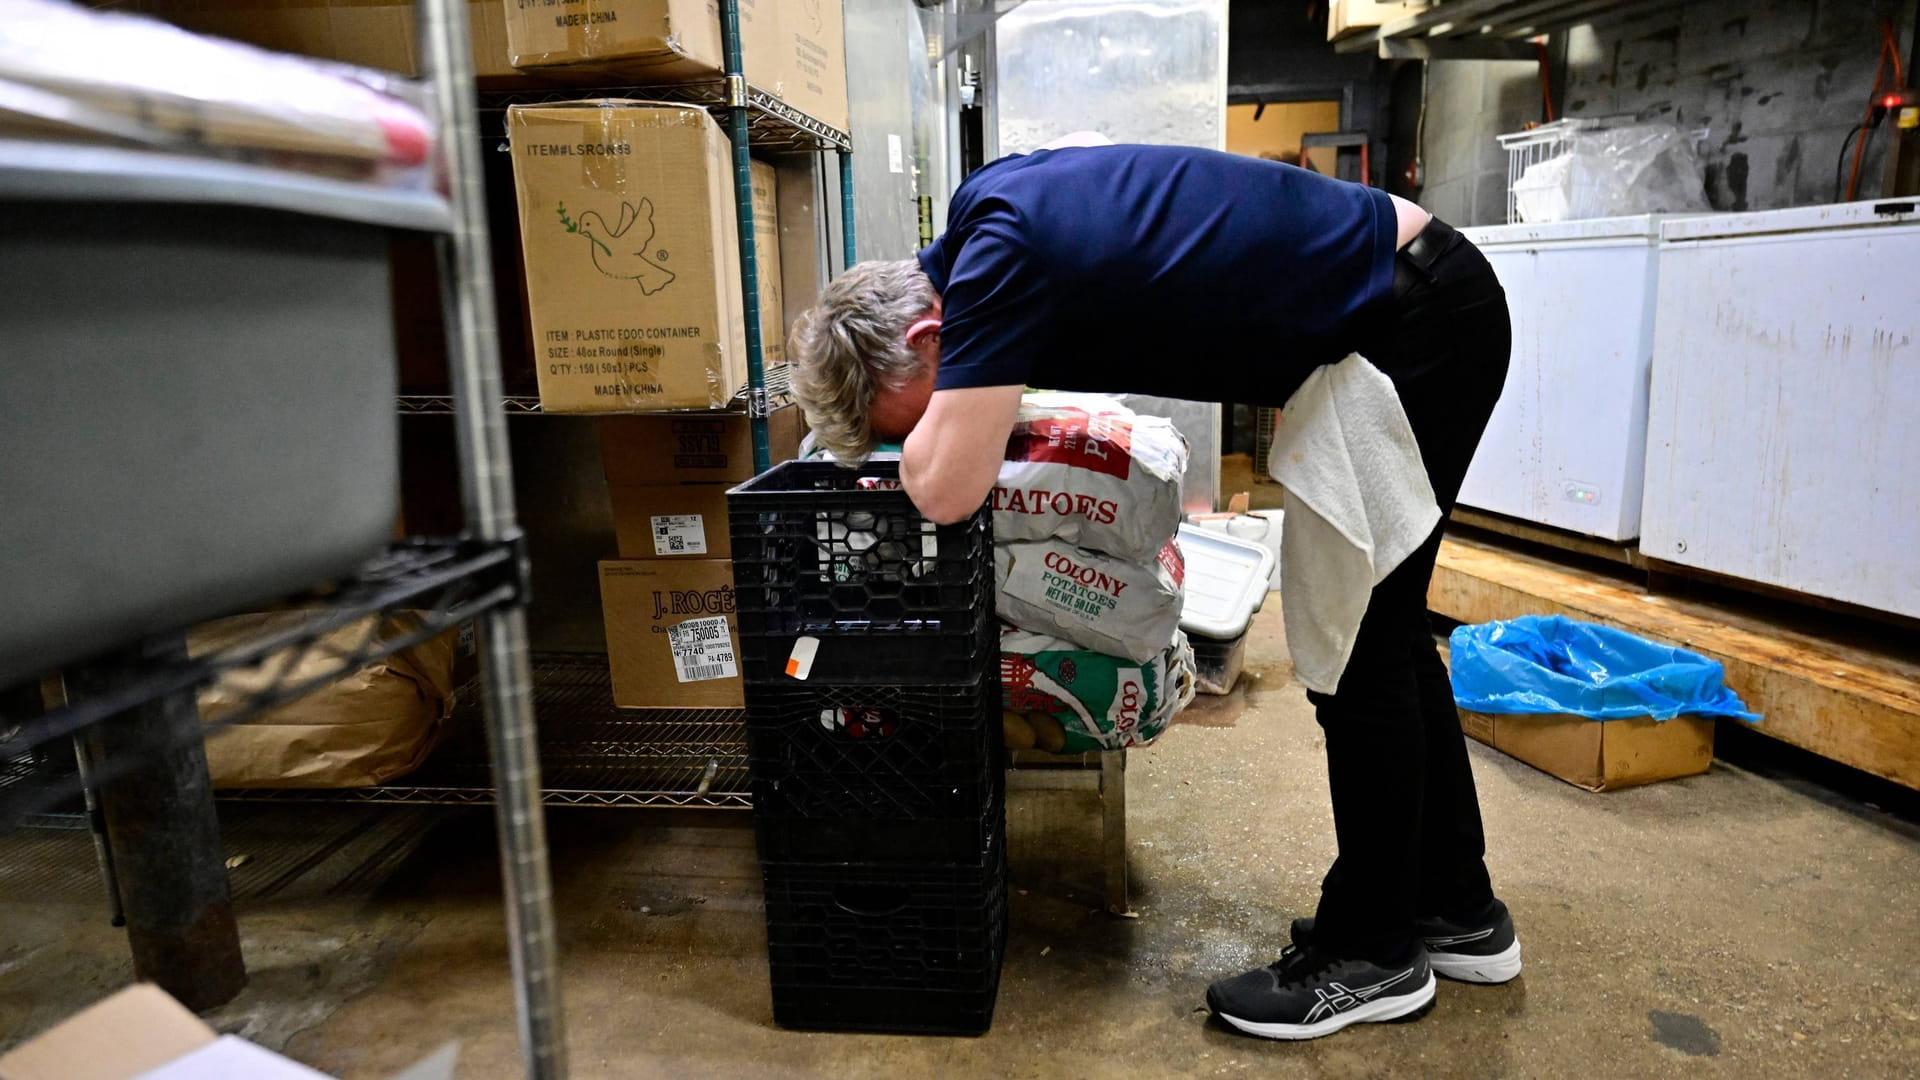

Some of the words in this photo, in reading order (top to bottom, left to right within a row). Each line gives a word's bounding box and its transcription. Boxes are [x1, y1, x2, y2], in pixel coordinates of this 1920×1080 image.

[556, 14, 580, 27] MADE
[591, 11, 617, 24] CHINA
[546, 331, 569, 342] ITEM
[576, 329, 616, 341] PLASTIC
[618, 328, 645, 340] FOOD
[646, 327, 700, 339] CONTAINER
[548, 347, 569, 358] SIZE
[599, 346, 628, 356] Round
[631, 345, 665, 358] (Single)
[579, 363, 594, 374] 150
[629, 362, 649, 373] PCS
[594, 384, 621, 396] MADE
[634, 383, 664, 394] CHINA
[1044, 551, 1128, 598] COLONY
[1041, 571, 1117, 610] POTATOES
[1045, 586, 1062, 601] NET
[1074, 598, 1086, 610] 50
[652, 590, 668, 620] J.
